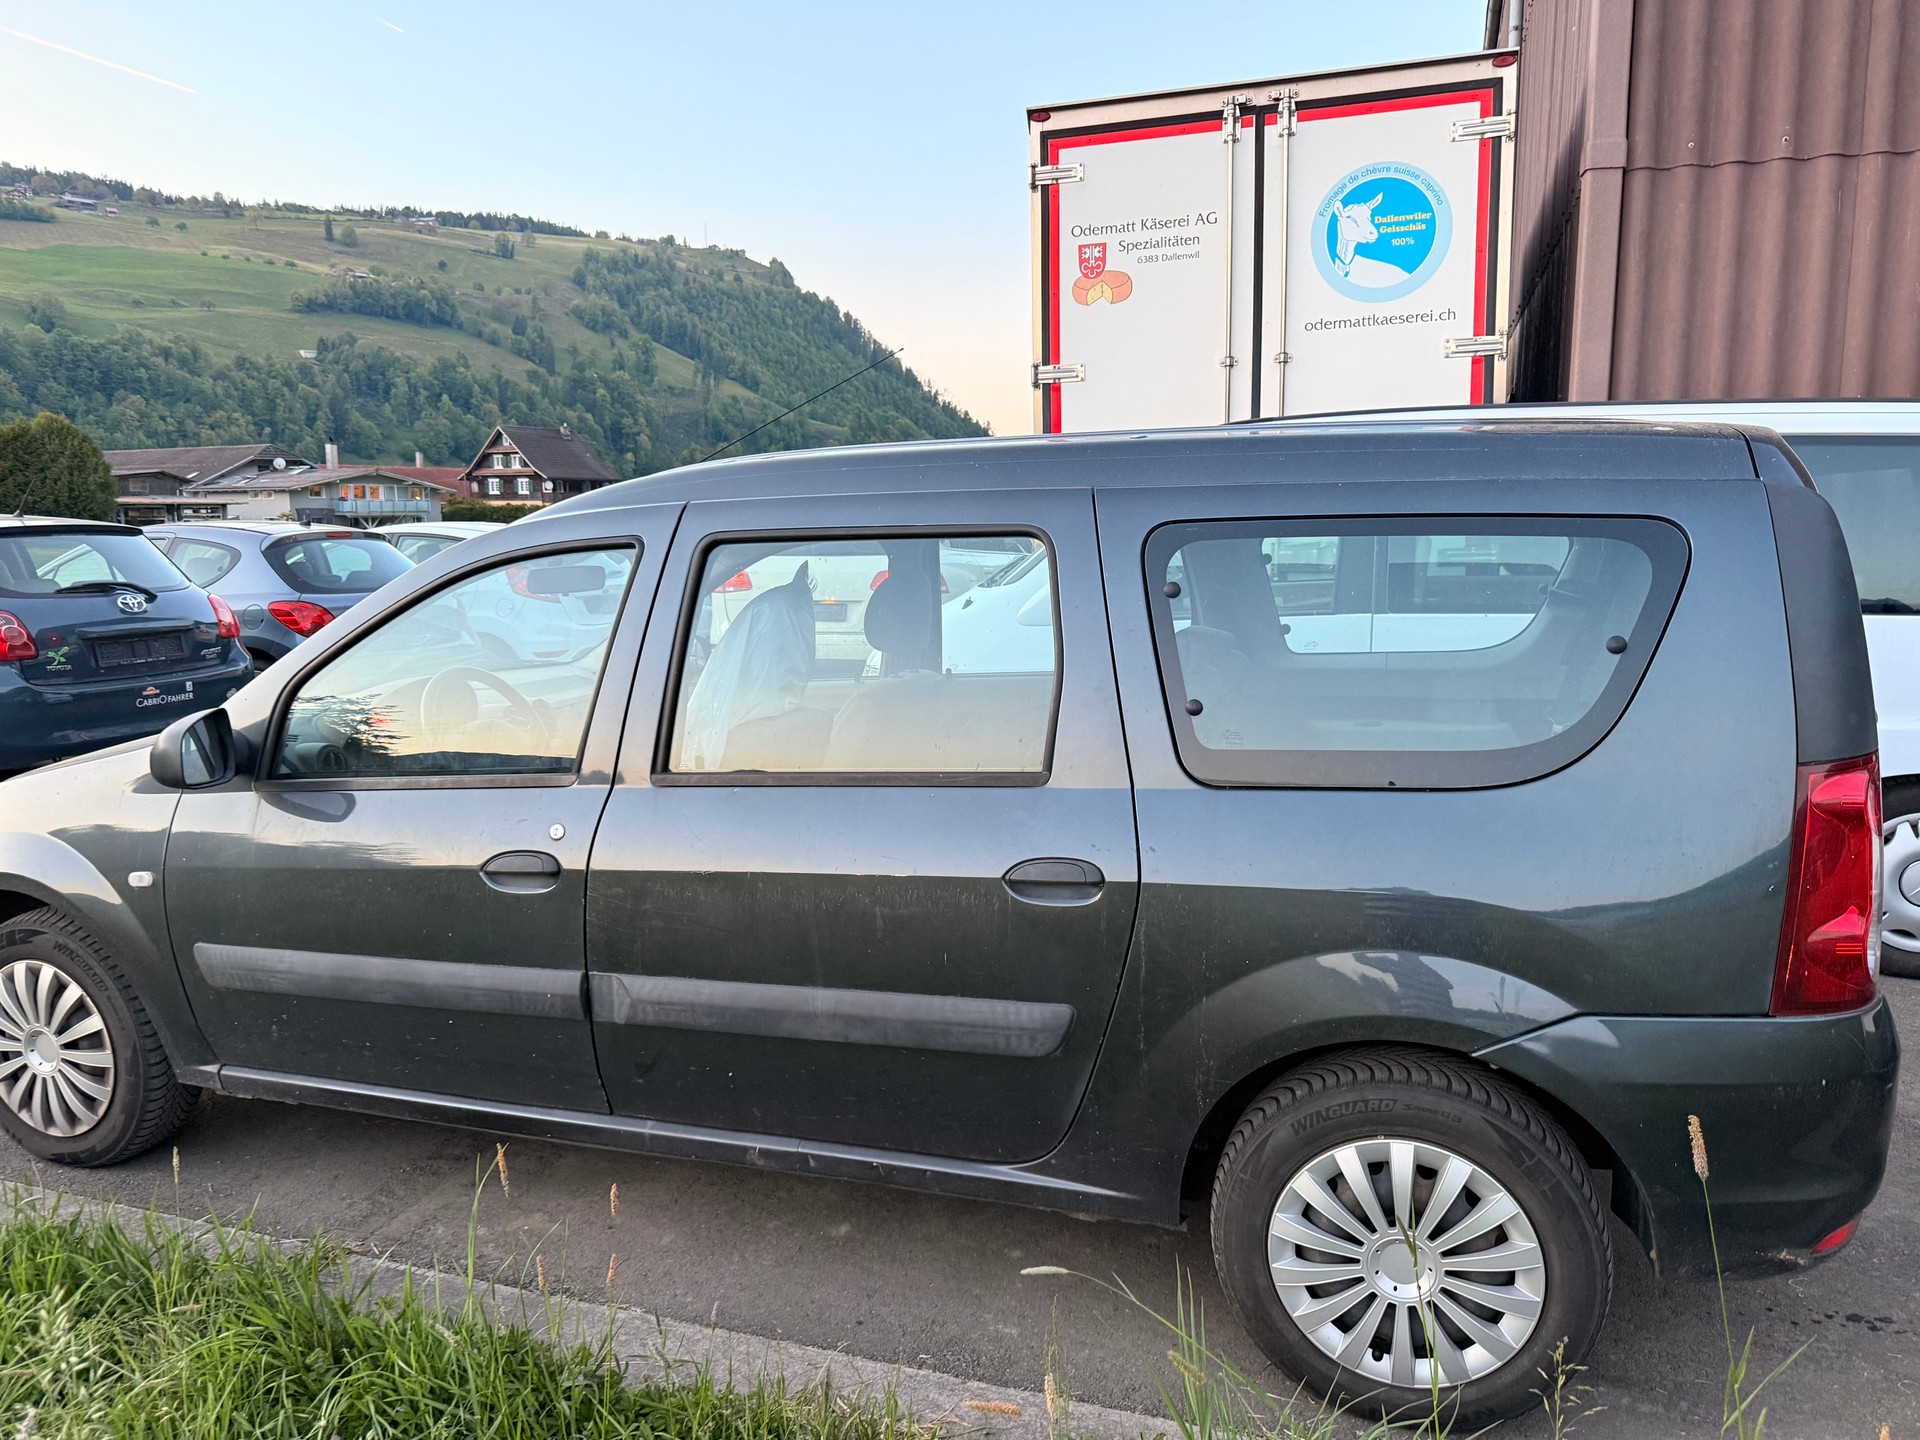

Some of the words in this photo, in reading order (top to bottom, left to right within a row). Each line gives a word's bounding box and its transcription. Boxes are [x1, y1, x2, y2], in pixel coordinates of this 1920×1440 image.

[1318, 182, 1348, 218] Fromage
[1347, 173, 1360, 185] de
[1360, 165, 1392, 178] chèvre
[1393, 165, 1421, 181] suisse
[1420, 177, 1443, 206] caprino
[1071, 221, 1136, 237] Odermatt
[1141, 214, 1190, 231] Käserei
[1195, 211, 1218, 226] AG
[1374, 212, 1432, 223] Dallenwiler
[1379, 223, 1426, 233] Geisschäs
[1118, 235, 1200, 254] Spezialitäten
[1391, 237, 1414, 246] 100%
[1137, 254, 1159, 264] 6383
[1161, 251, 1200, 262] Dallenwil
[1304, 308, 1456, 332] odermattkaeserei.ch
[46, 664, 73, 672] TOYOTA
[1289, 1098, 1398, 1137] WINGUARD
